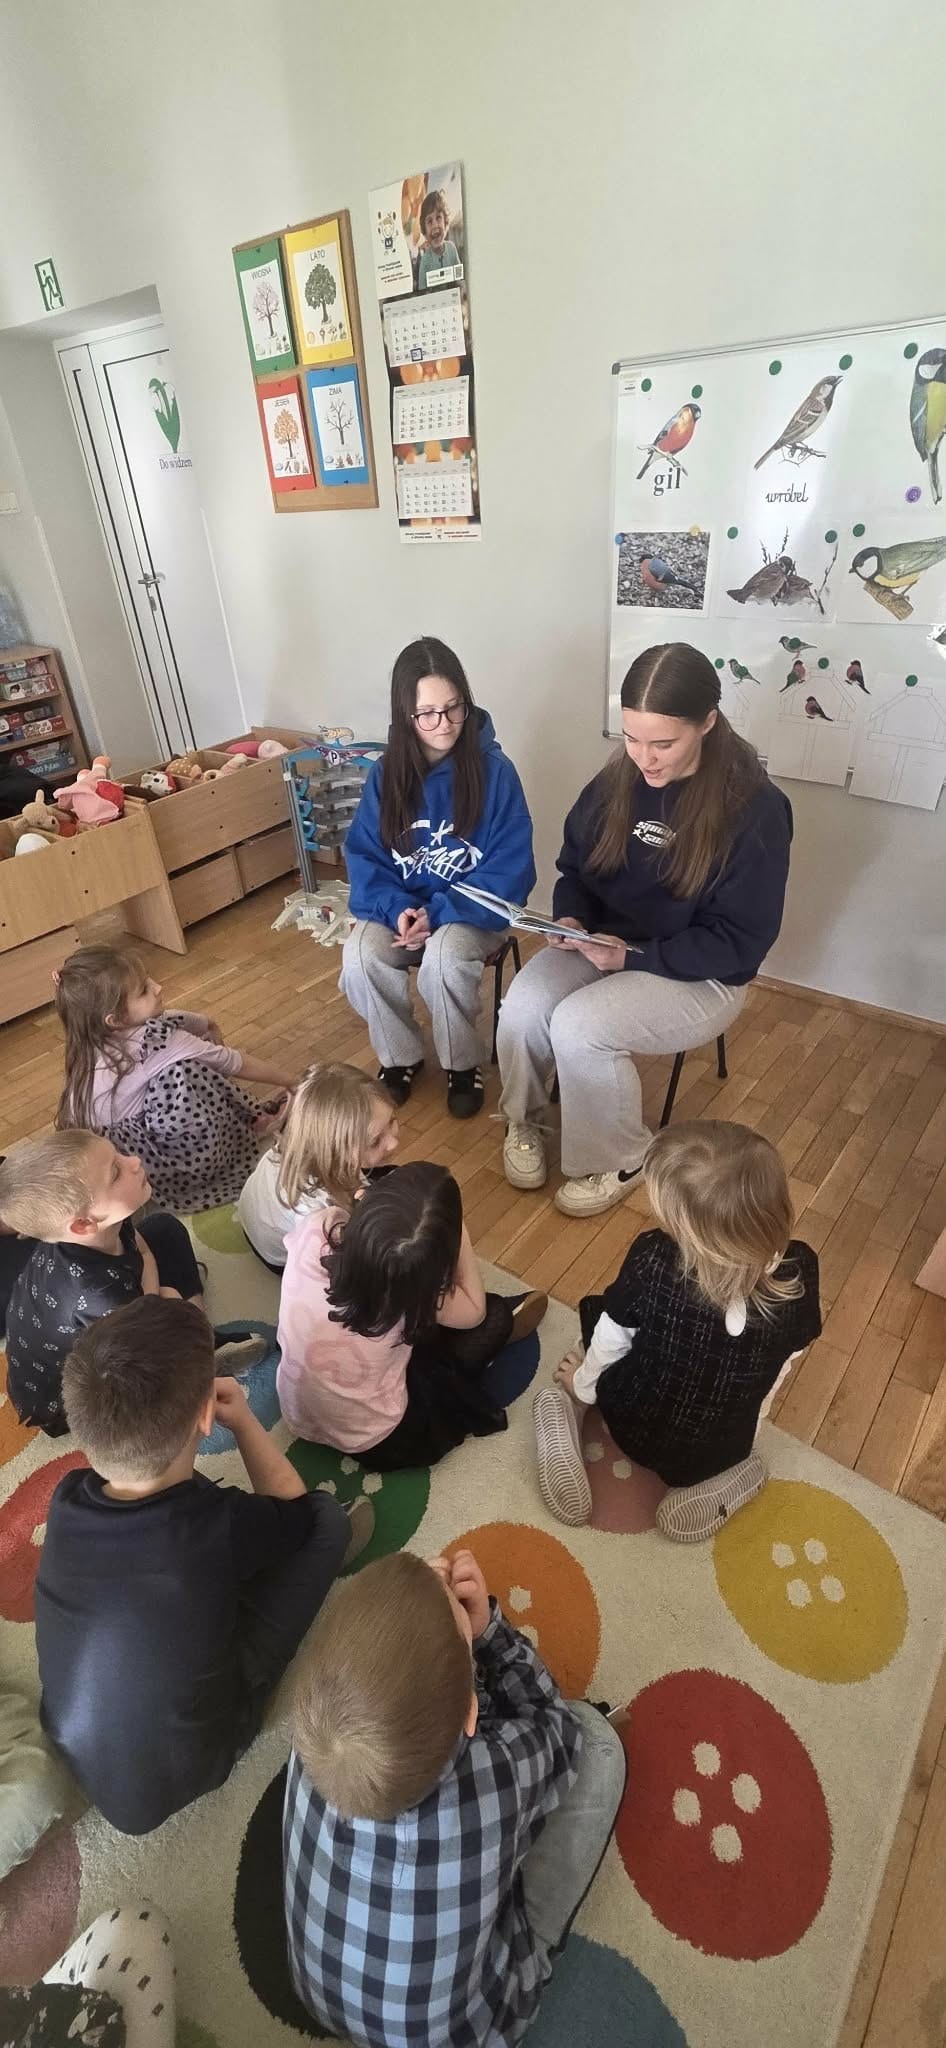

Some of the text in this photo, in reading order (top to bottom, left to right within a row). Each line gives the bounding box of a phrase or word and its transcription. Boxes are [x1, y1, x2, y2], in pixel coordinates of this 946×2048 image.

[653, 467, 681, 497] gil
[765, 482, 809, 503] wróbel
[331, 752, 338, 763] P
